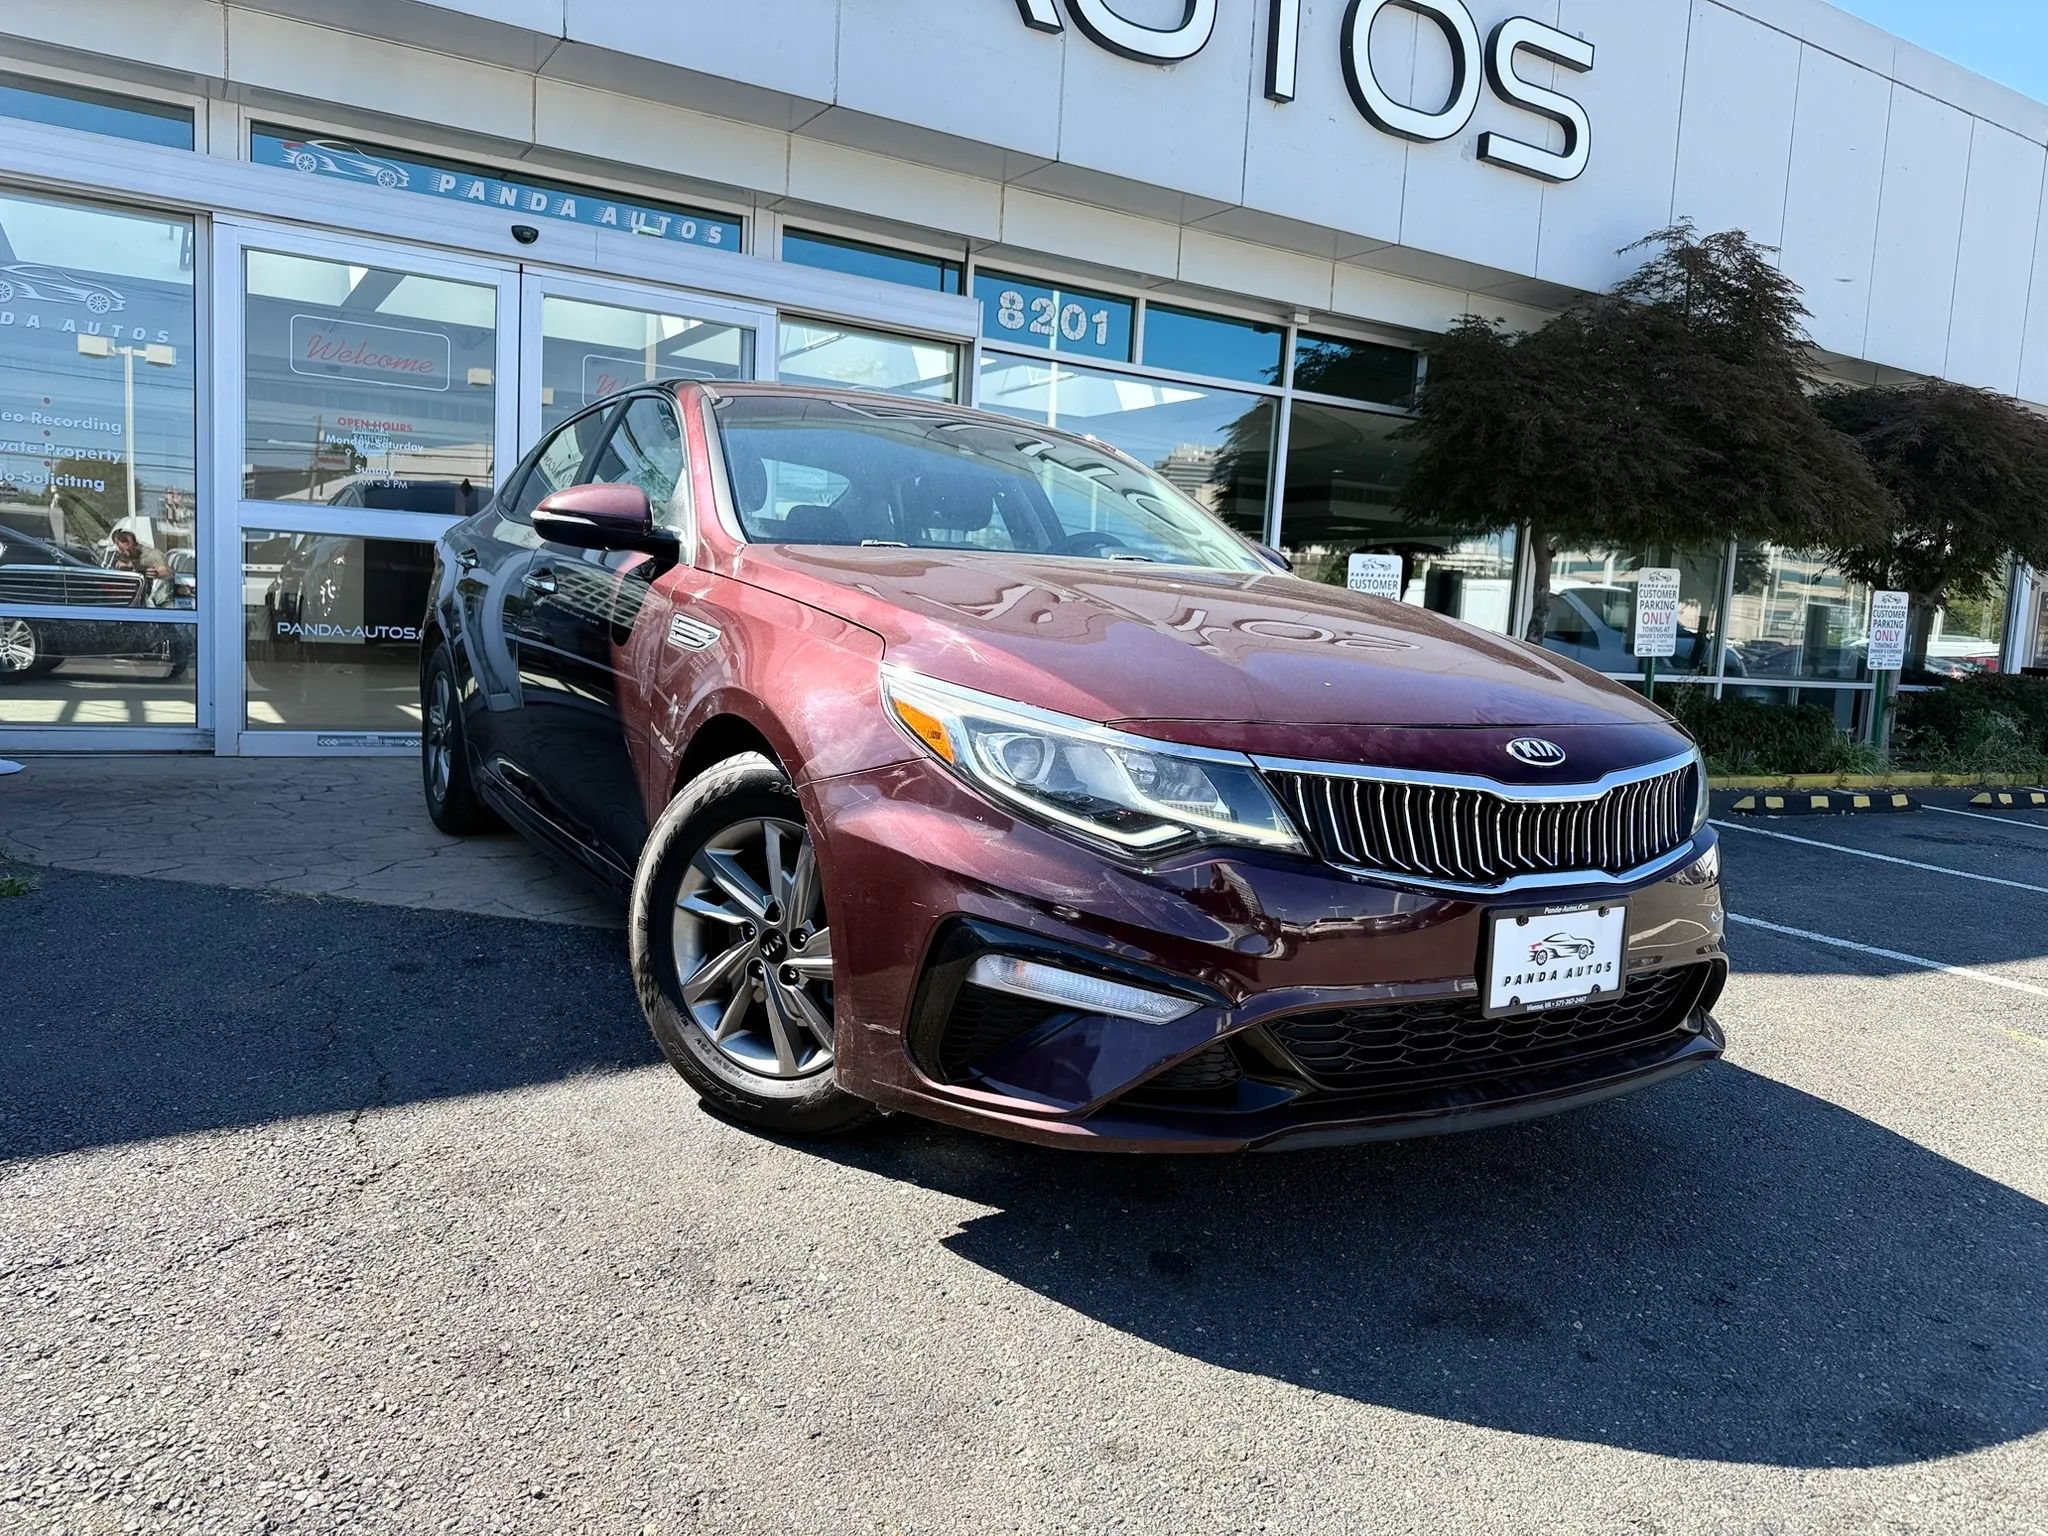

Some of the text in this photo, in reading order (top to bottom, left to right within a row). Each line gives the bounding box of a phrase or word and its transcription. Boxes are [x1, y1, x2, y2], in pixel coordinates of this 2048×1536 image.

[437, 173, 723, 245] PANDA AUTOS
[997, 290, 1108, 345] 8201
[61, 319, 169, 343] AUTOS
[306, 334, 435, 374] Welcome
[31, 411, 123, 436] Recording
[337, 417, 414, 433] OPEN HOURS
[44, 442, 122, 464] Property
[354, 464, 396, 478] Sunday
[22, 470, 105, 492] Soliciting
[383, 479, 390, 488] 3
[393, 480, 408, 490] PM
[1349, 579, 1398, 590] CUSTOMER
[1638, 588, 1677, 599] CUSTOMER
[1639, 600, 1675, 611] PARKING
[1872, 609, 1905, 618] CUSTOMER
[1642, 611, 1671, 625] ONLY
[1873, 619, 1904, 629] PARKING
[1874, 630, 1900, 642] ONLY
[761, 935, 783, 956] KIA
[1502, 961, 1612, 987] PANDA AUTOS
